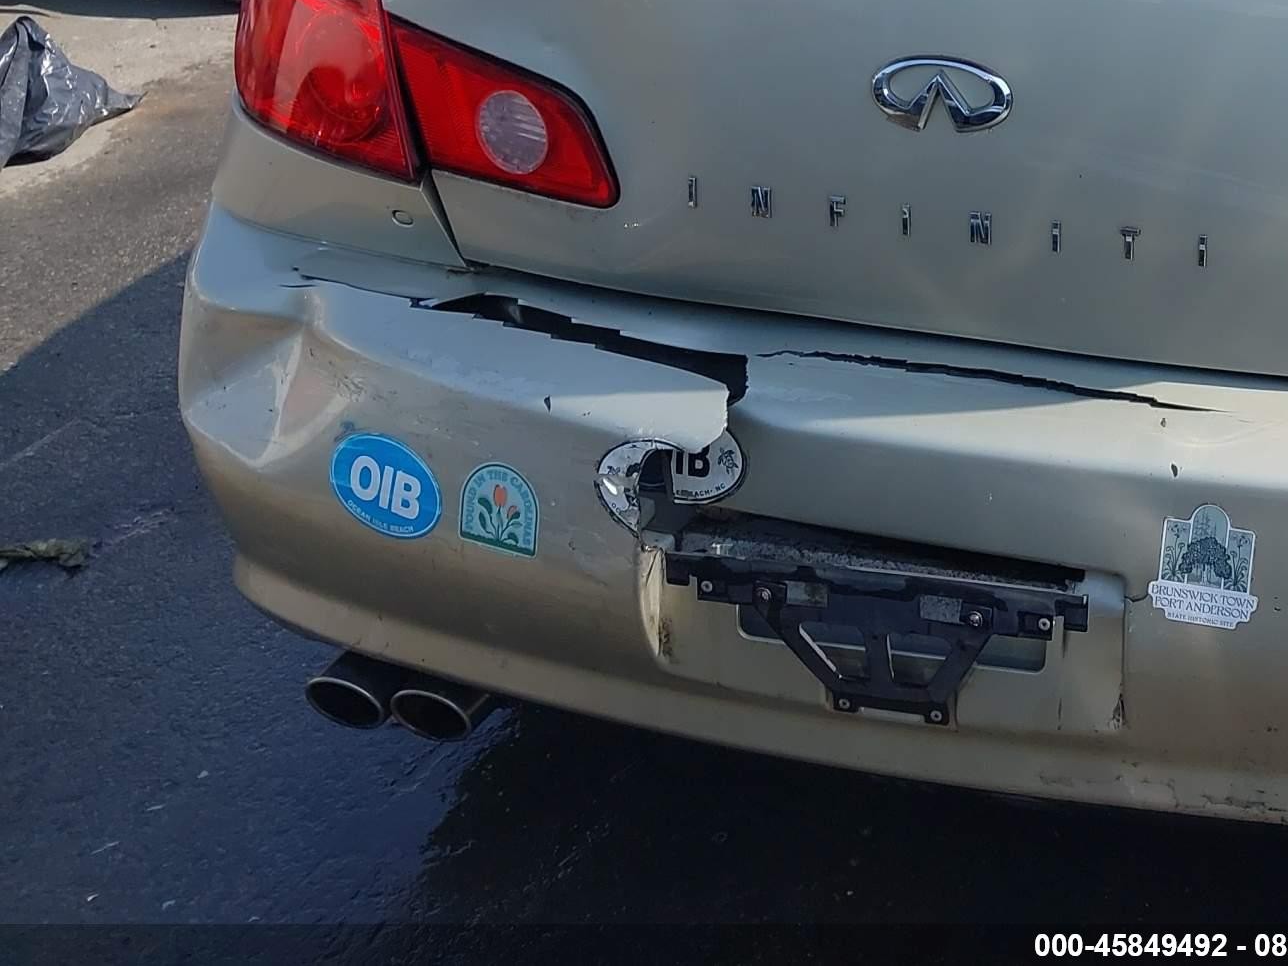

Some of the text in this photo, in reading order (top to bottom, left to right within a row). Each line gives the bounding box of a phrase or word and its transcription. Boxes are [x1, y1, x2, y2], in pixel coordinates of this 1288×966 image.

[688, 175, 1208, 267] INFINITI
[486, 469, 508, 482] THE
[350, 455, 422, 520] OIB
[715, 483, 726, 492] NC
[347, 500, 371, 522] OCEAN
[1151, 584, 1255, 610] BRUNSWICK TOWN
[1155, 595, 1249, 620] FORT ANDERSON
[1187, 616, 1219, 625] HISTORIC
[1220, 620, 1234, 628] SITE
